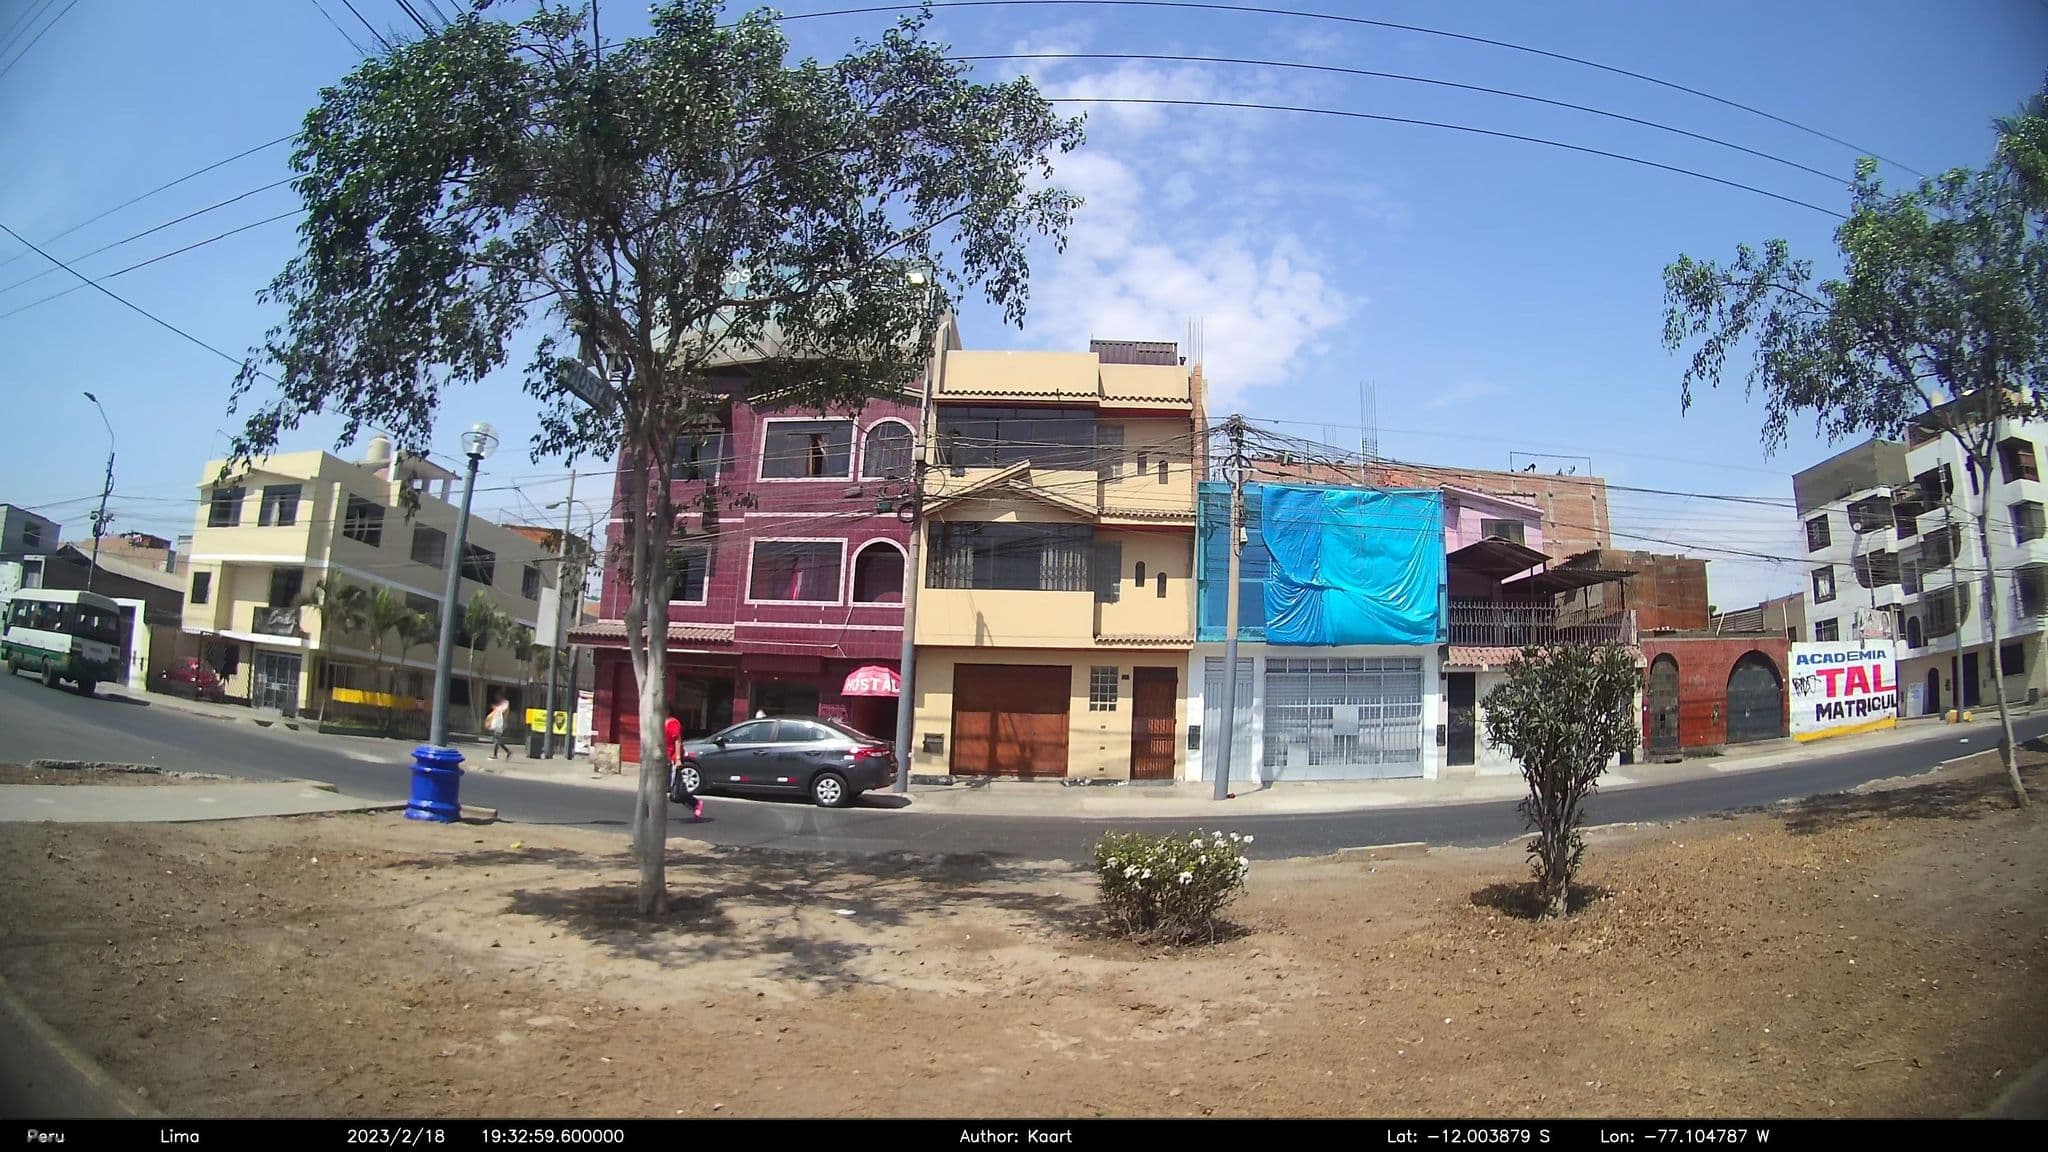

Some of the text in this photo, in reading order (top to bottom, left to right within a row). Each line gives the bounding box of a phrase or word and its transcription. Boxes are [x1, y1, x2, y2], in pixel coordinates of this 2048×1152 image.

[1796, 649, 1887, 665] ACADEMIA
[846, 677, 900, 692] HOSTAL
[1815, 663, 1897, 698] TAL
[1815, 693, 1897, 721] MATRICUL
